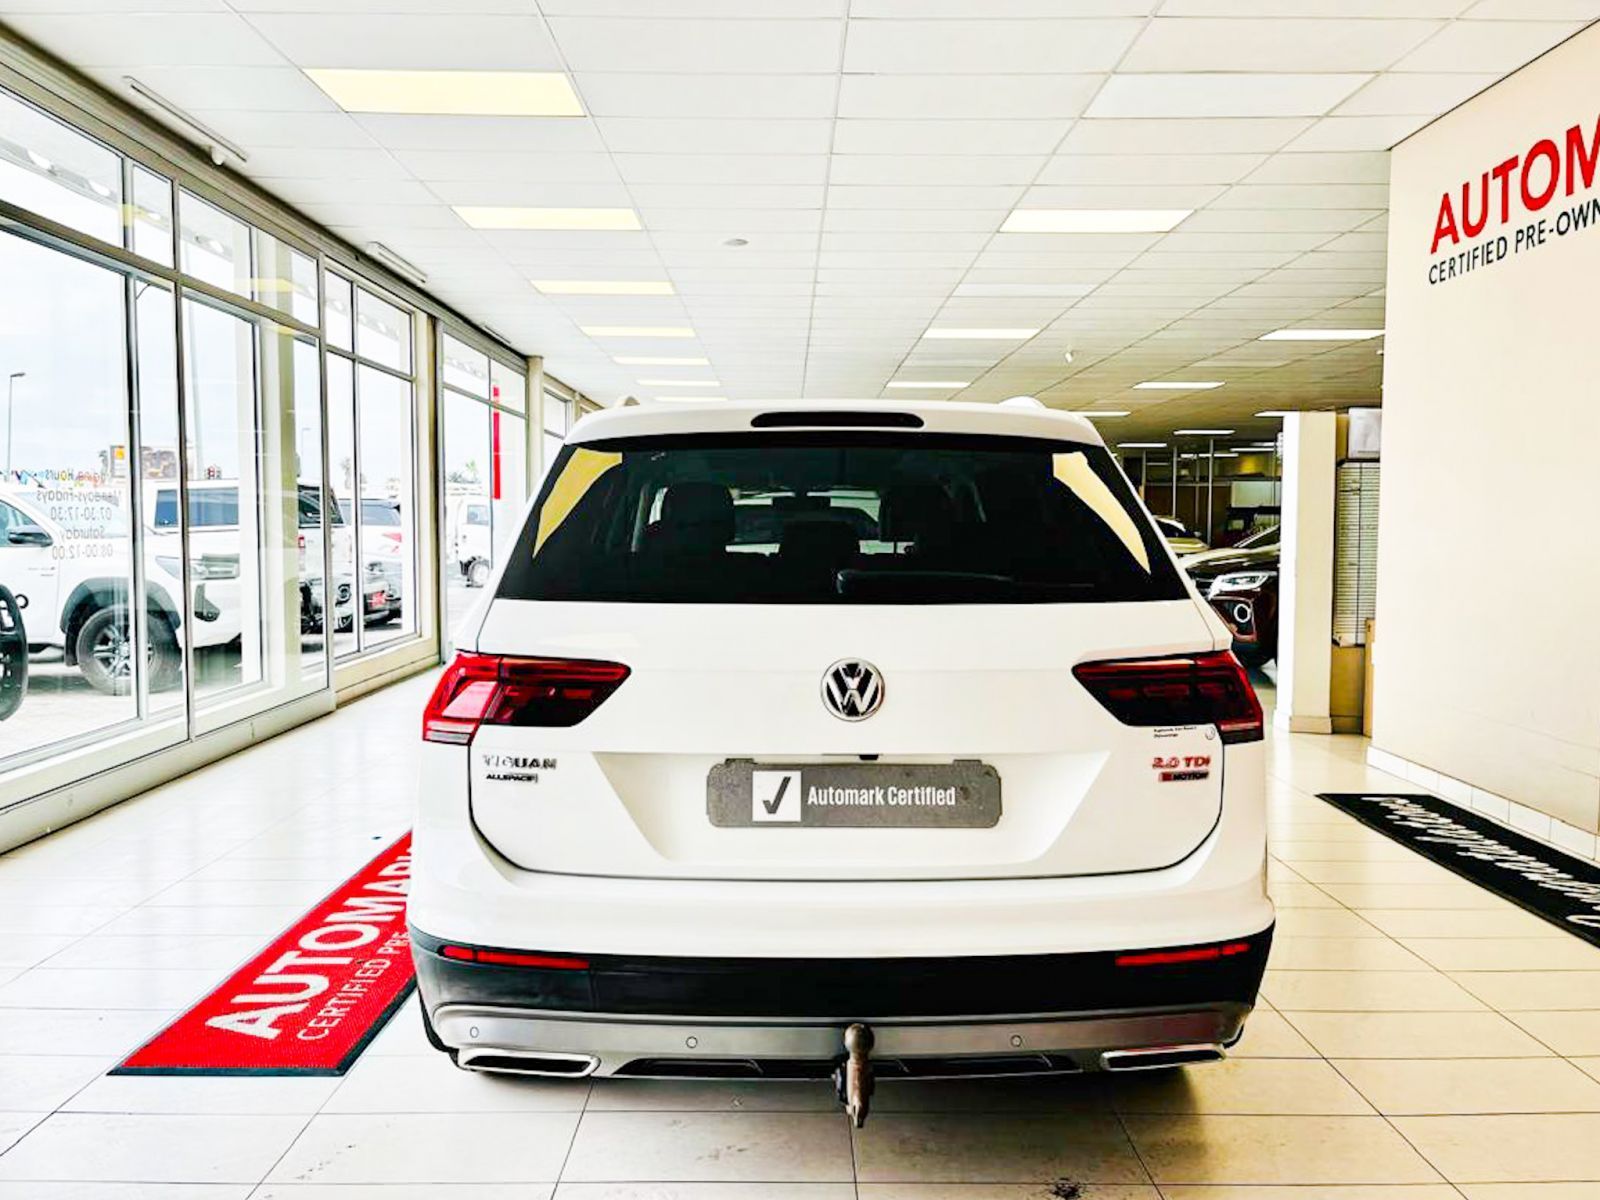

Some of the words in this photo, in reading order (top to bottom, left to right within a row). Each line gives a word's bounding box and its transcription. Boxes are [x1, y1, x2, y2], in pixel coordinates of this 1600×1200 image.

[1430, 112, 1600, 255] AUTOM
[1428, 236, 1508, 286] CERTIFIED
[1152, 757, 1180, 769] 2.0
[1183, 755, 1211, 767] TDI
[807, 786, 885, 806] Automark
[887, 786, 956, 806] Certified
[205, 847, 412, 1040] AUTOMAR
[297, 958, 391, 1041] CERTIFIED
